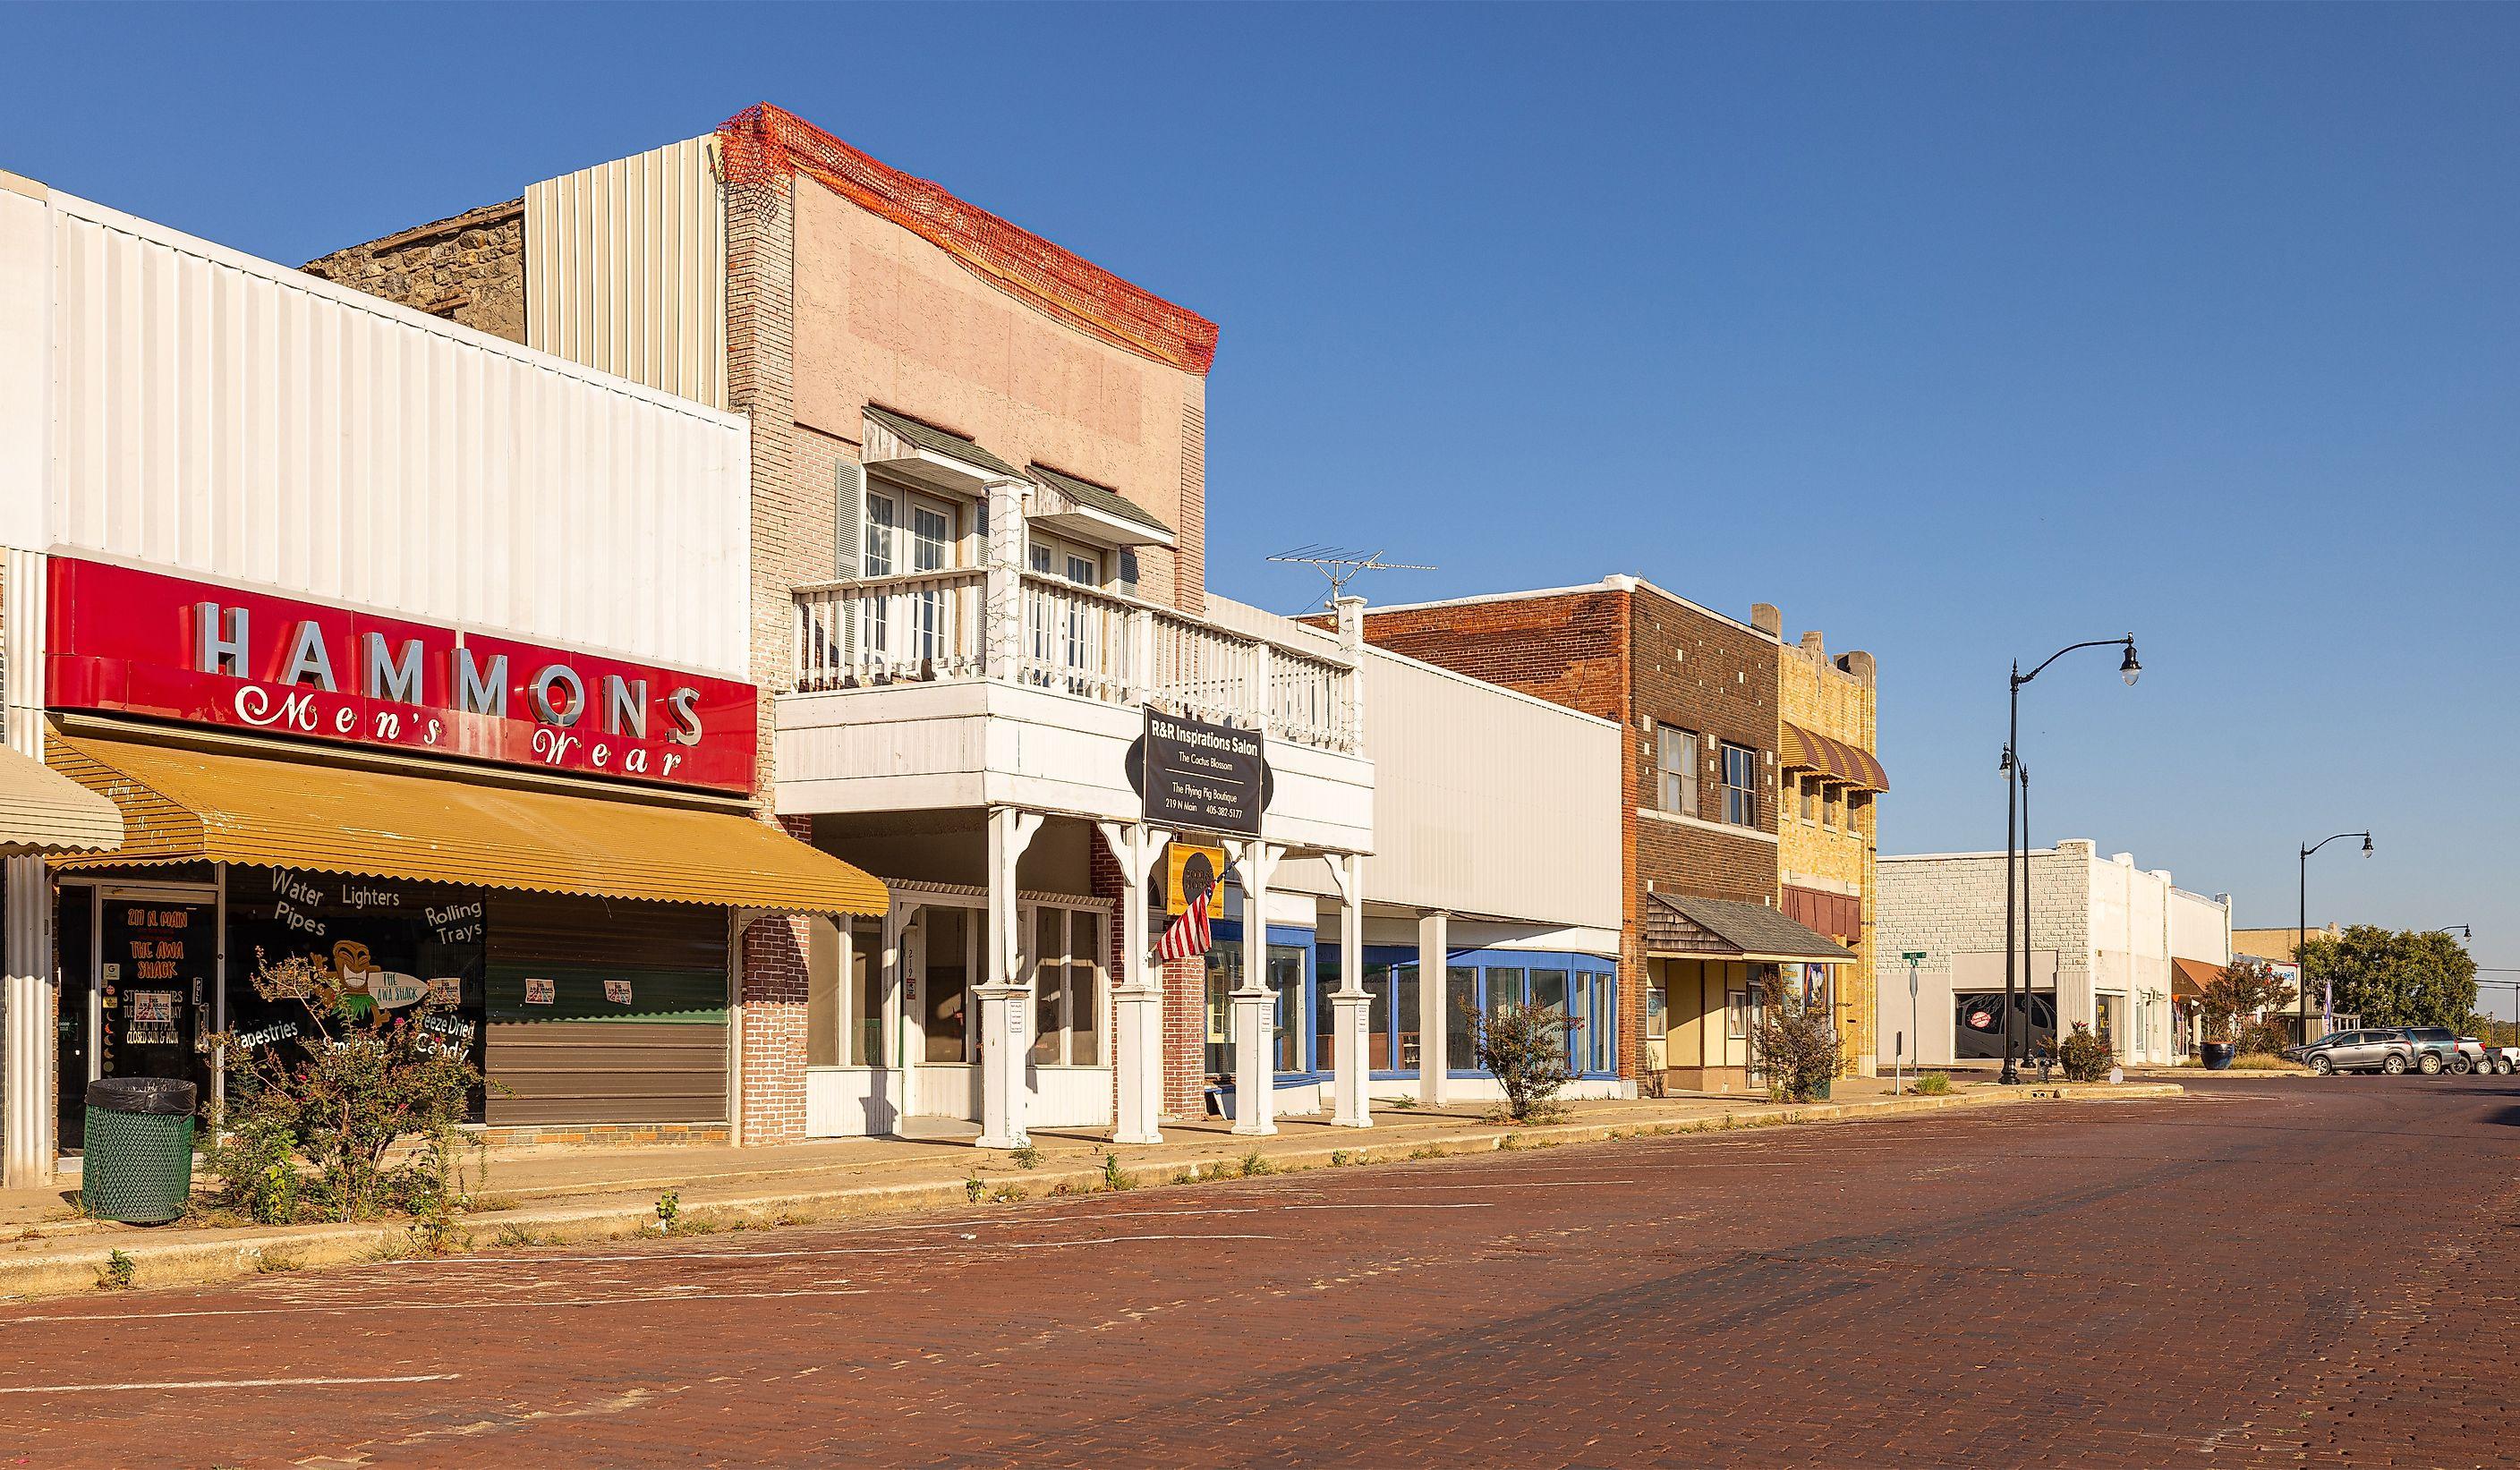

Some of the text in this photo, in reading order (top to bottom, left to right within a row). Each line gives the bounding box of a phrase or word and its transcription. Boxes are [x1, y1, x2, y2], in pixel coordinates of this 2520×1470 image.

[196, 601, 702, 746] HAMMONS
[234, 685, 682, 776] Men's Wear
[1151, 719, 1258, 757] R&R Inspirations Salon
[1179, 752, 1233, 771] The Cactus Blossom
[1172, 782, 1238, 803] The Flying Pig Boutique
[1165, 798, 1177, 809] 219
[272, 868, 325, 907] Water
[342, 884, 400, 909] Lighters
[128, 908, 144, 926] 217
[160, 911, 187, 928] MAIN
[274, 901, 326, 936] Pipes
[424, 901, 482, 927] Rolling
[437, 922, 482, 945] Trays
[130, 940, 184, 959] THE AWA
[138, 961, 177, 979] SHACK
[383, 973, 397, 987] THE
[377, 988, 393, 1002] AWA
[396, 987, 418, 1001] SHACK
[126, 1031, 147, 1044] CLOSED
[148, 1031, 159, 1044] SUN
[166, 1032, 179, 1044] MON
